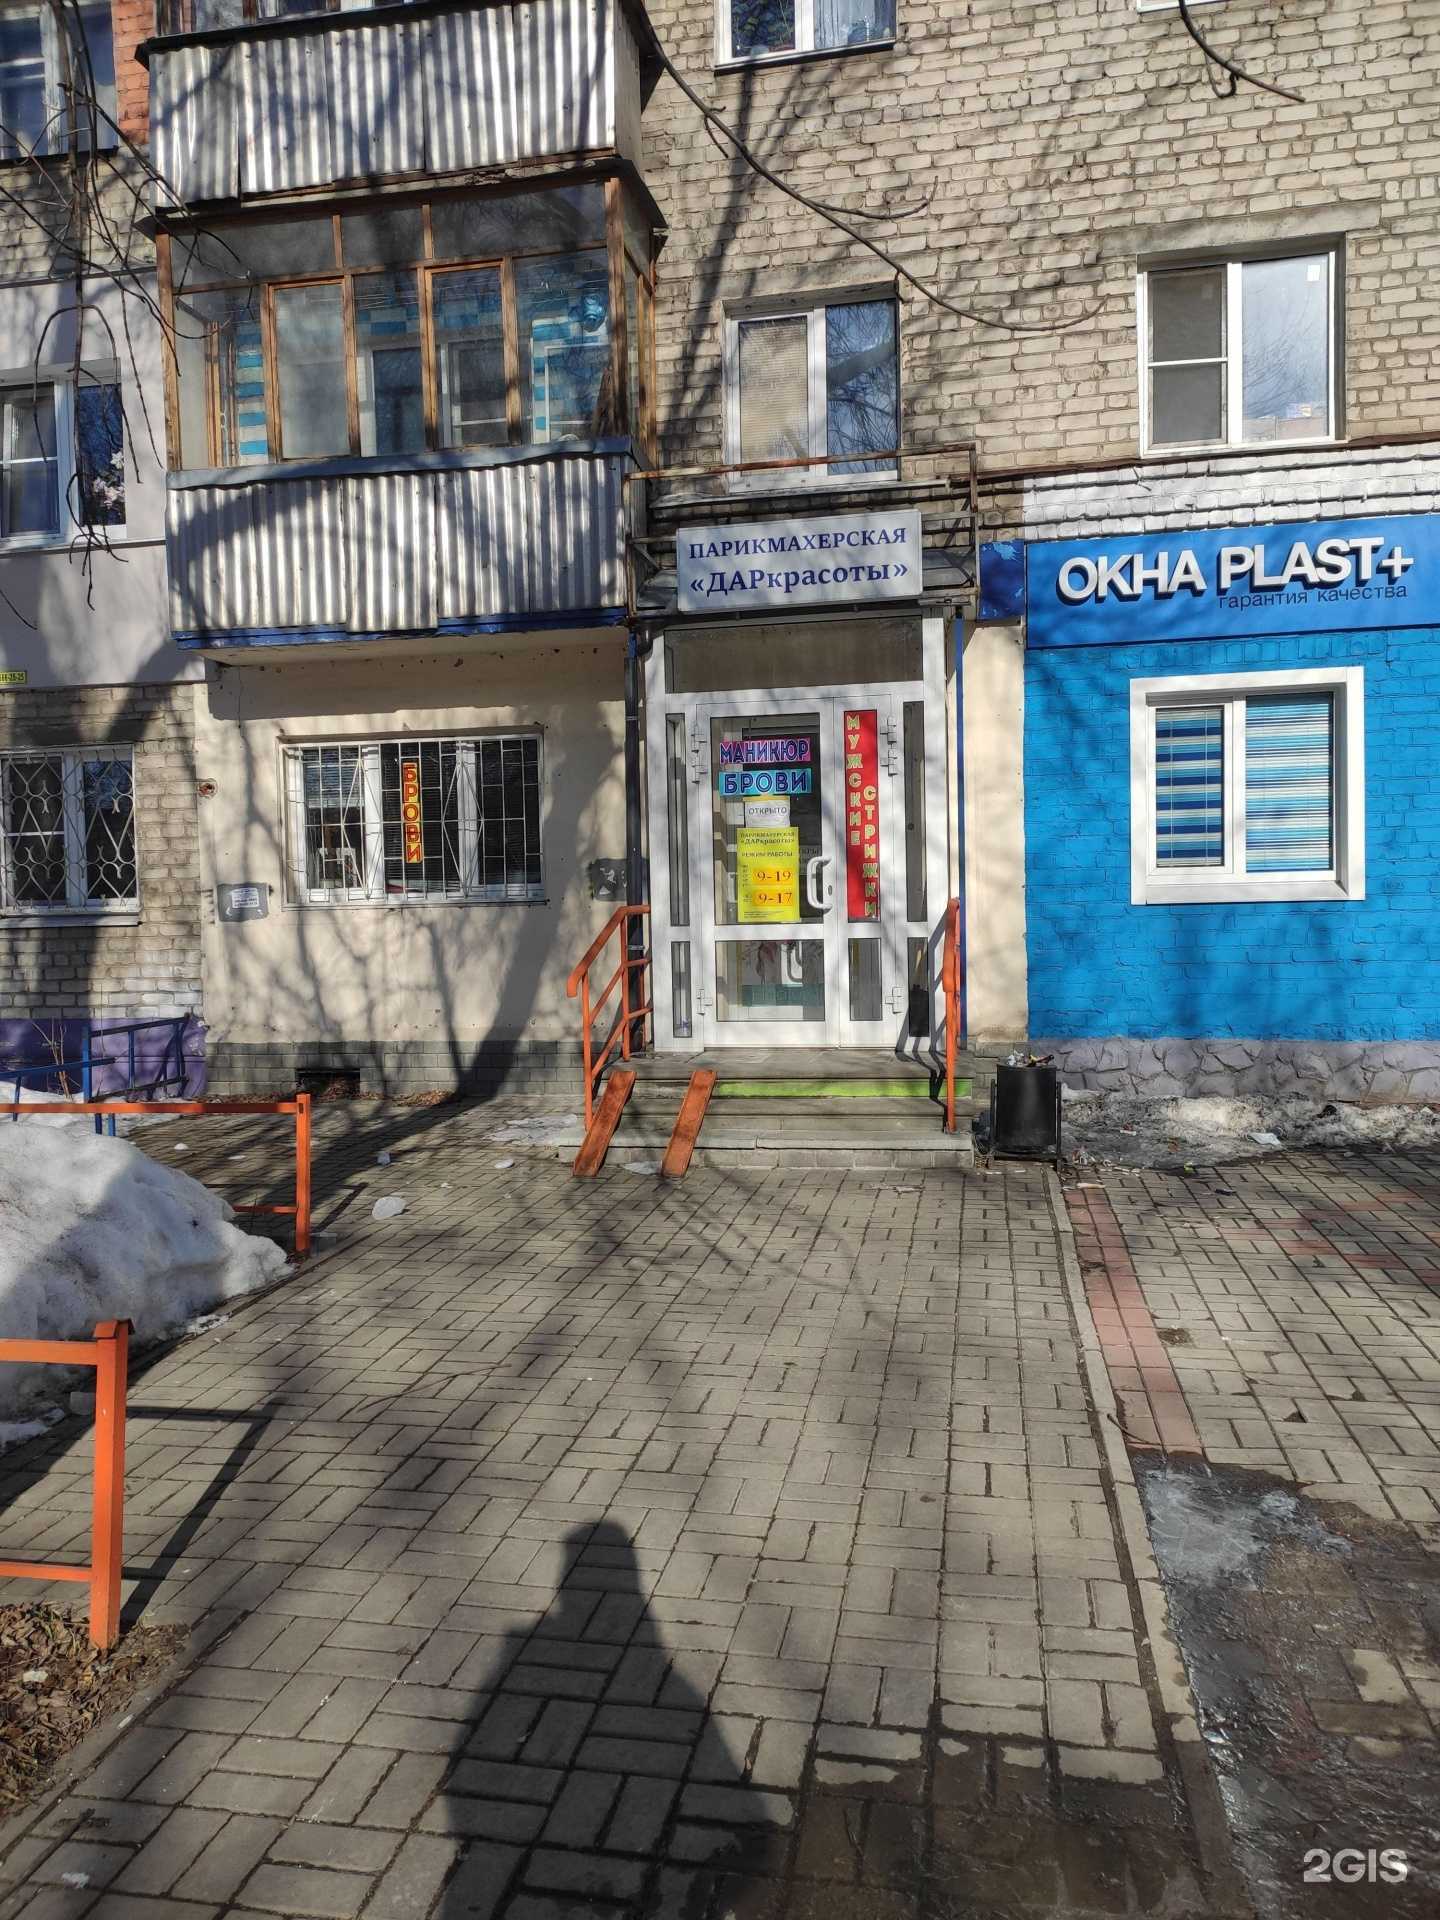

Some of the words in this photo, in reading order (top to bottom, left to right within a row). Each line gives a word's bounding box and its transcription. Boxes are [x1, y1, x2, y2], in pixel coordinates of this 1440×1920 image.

[688, 527, 908, 559] ПАРИКМАХЕРСКАЯ
[689, 562, 909, 597] «ДАРкрасоты»
[1056, 549, 1208, 602] ОКНА
[1217, 536, 1415, 596] PLAST+
[1218, 591, 1308, 611] гарантия
[1317, 584, 1408, 602] качества
[720, 739, 809, 764] МАНИКЮР
[724, 771, 807, 794] БРОВИ
[846, 714, 864, 846] МУЖСКИЕ
[402, 762, 421, 863] БРОВИ
[748, 806, 787, 815] ОТКРЫТО
[862, 785, 879, 917] СТРИЖКИ
[757, 870, 791, 883] 9-19
[758, 892, 793, 904] 9-17
